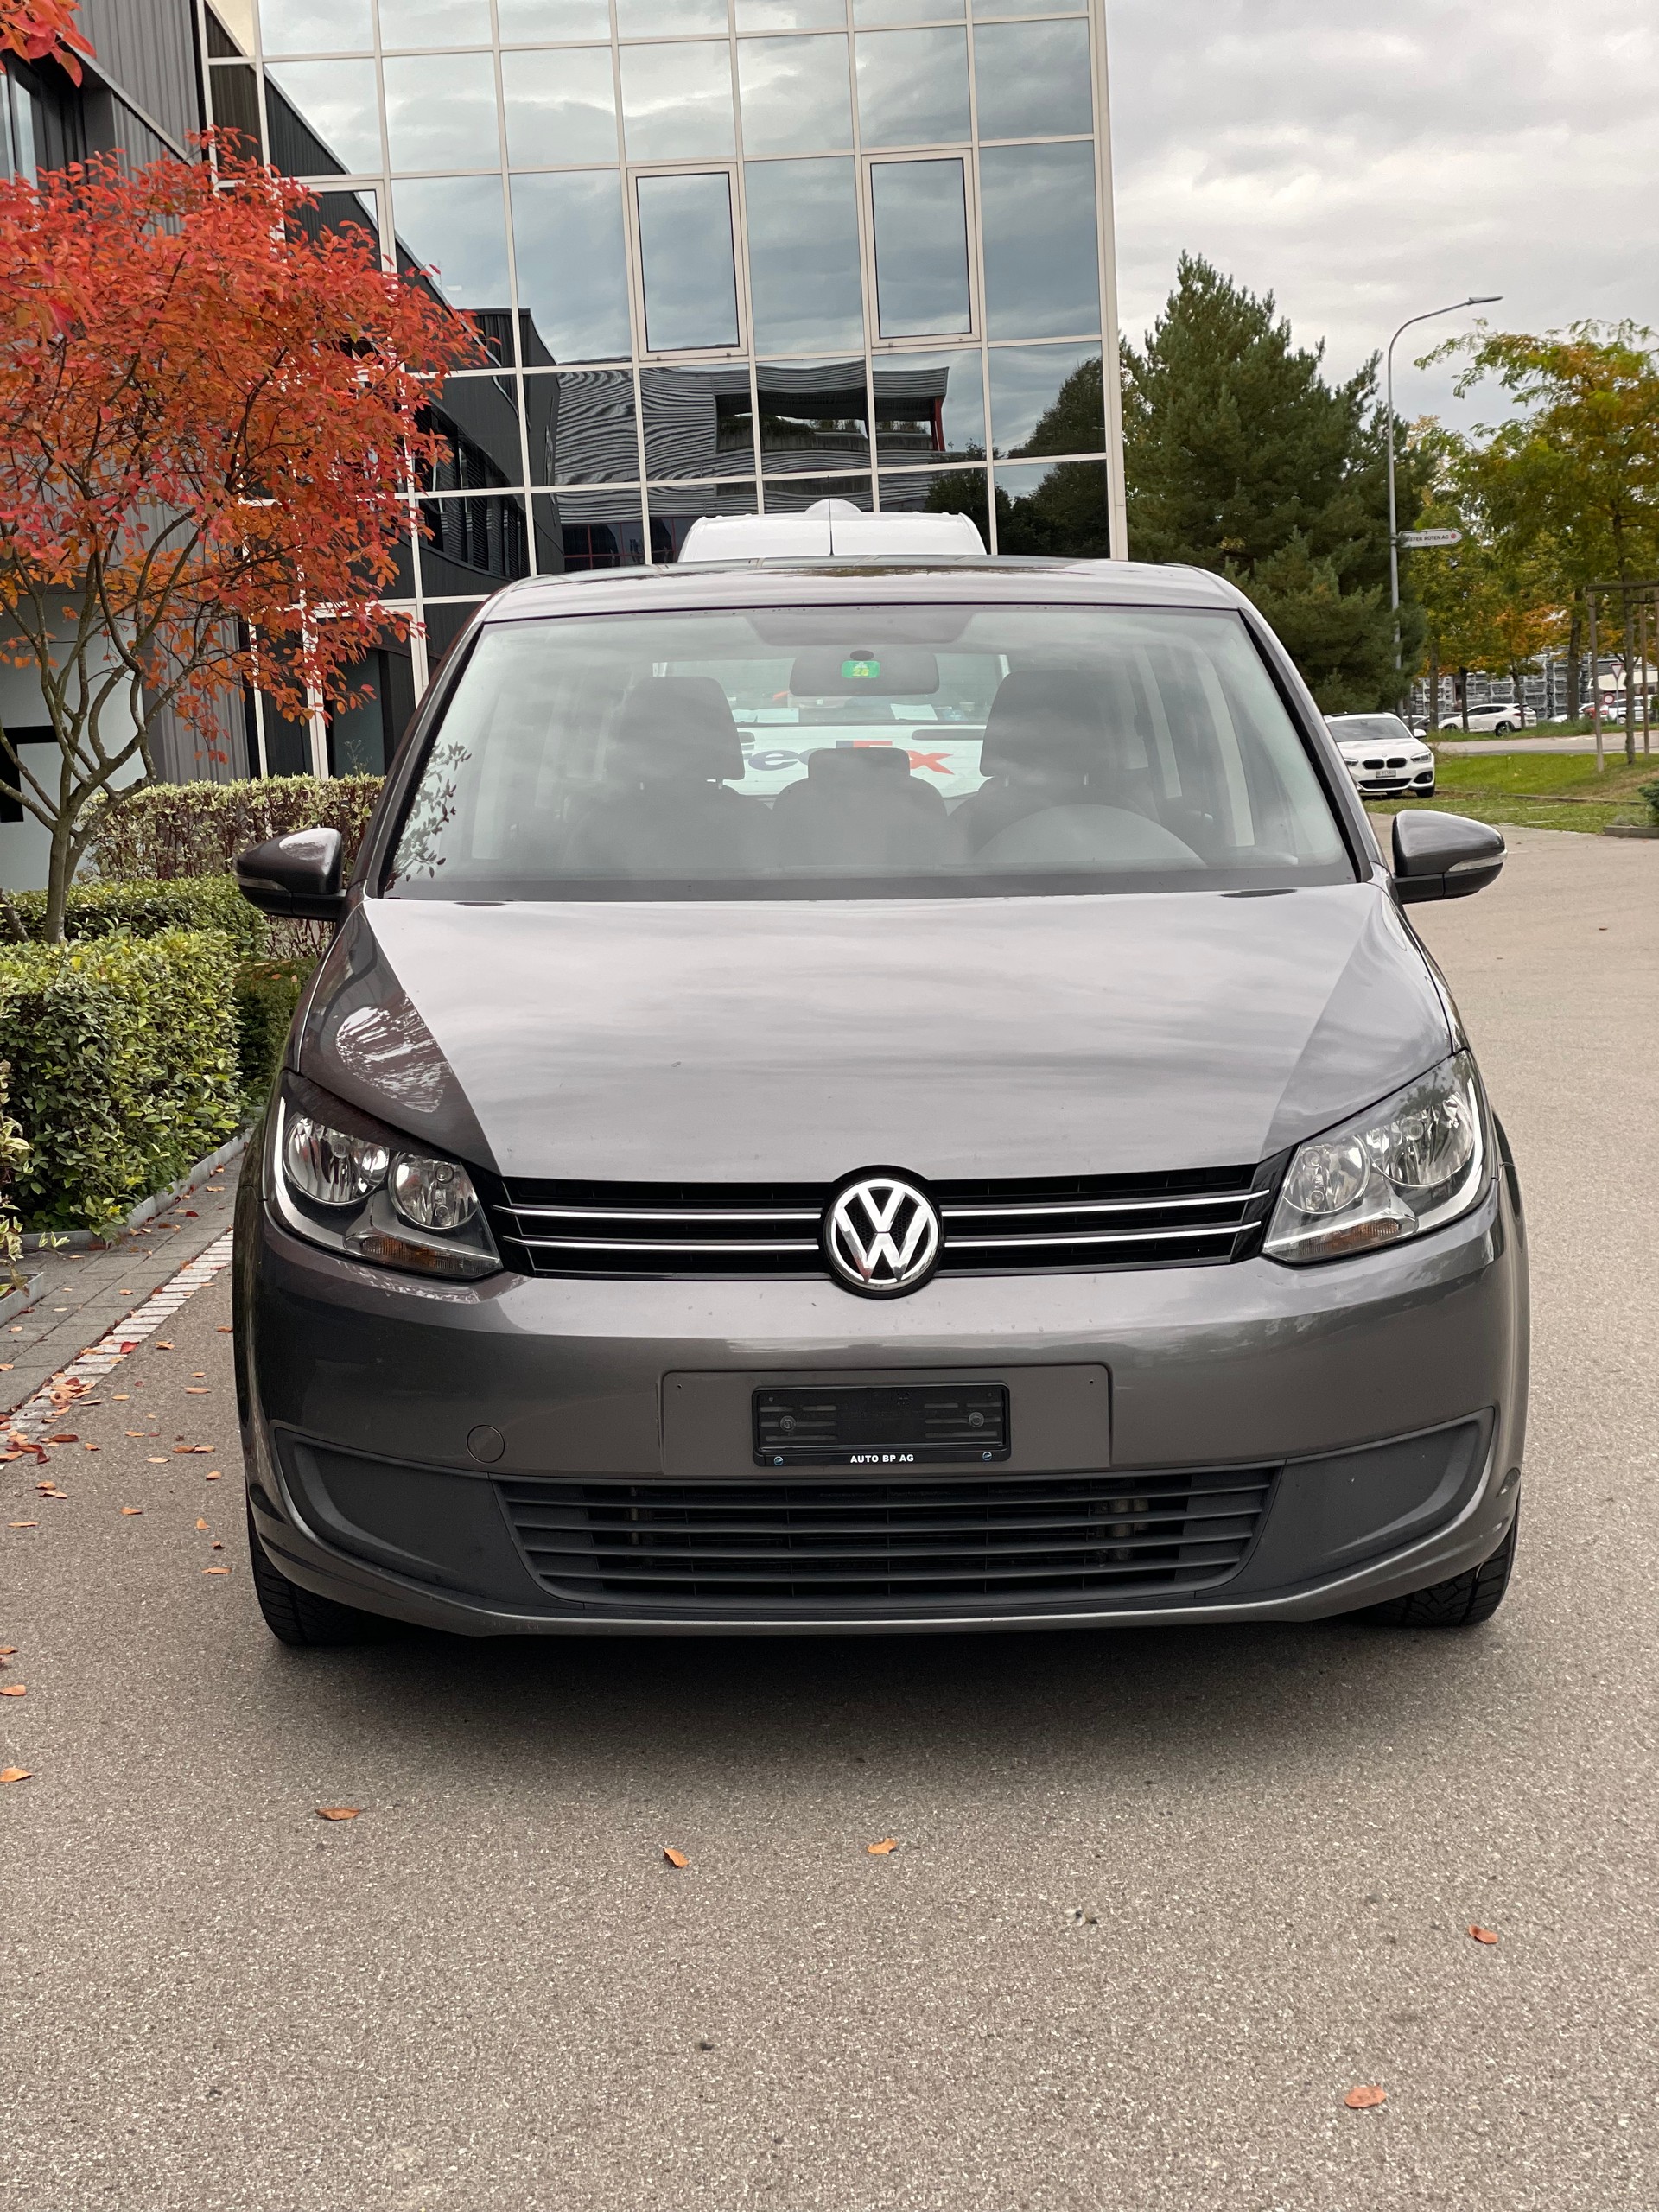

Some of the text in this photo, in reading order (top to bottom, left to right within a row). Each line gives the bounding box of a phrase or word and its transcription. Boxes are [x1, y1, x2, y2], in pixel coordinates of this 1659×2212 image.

[833, 1182, 932, 1286] VW
[850, 1453, 914, 1464] AUTO BP AG
